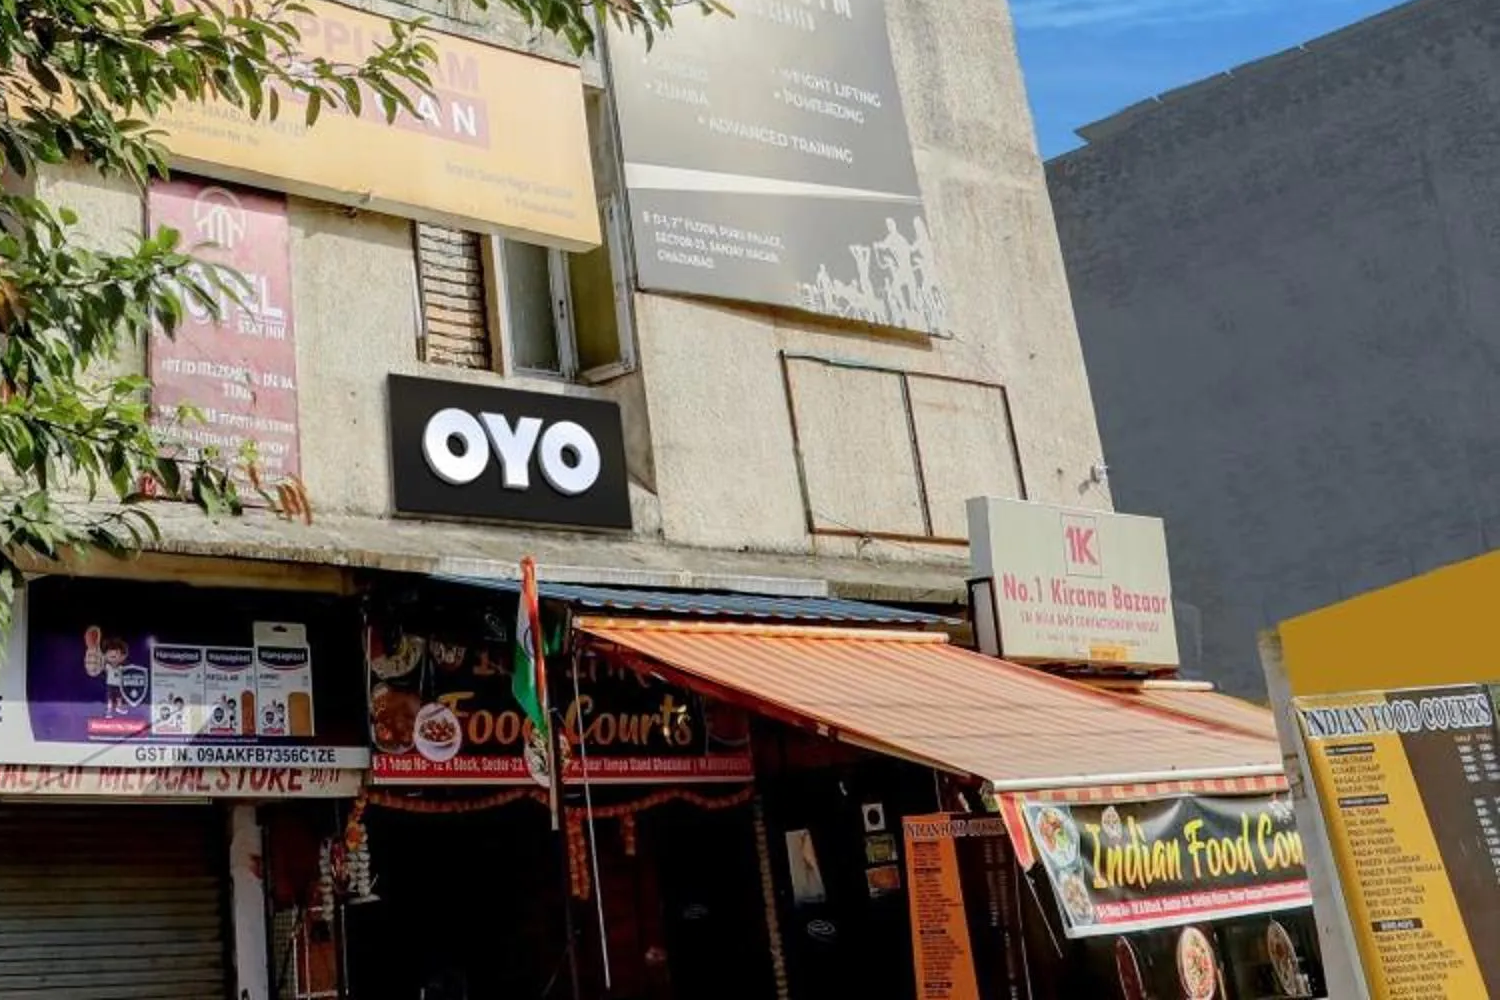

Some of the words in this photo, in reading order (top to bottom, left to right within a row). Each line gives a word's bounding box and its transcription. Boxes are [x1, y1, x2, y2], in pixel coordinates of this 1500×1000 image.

[709, 117, 788, 148] ADVANCED
[791, 135, 853, 164] TRAINING
[422, 408, 600, 495] OYO
[1065, 525, 1099, 565] 1K
[1003, 572, 1043, 603] No.1
[1051, 577, 1107, 609] Kirana
[1111, 583, 1167, 615] Bazaar
[565, 693, 693, 748] Courts
[1371, 701, 1420, 733] FOOD
[1421, 693, 1493, 730] COURTS
[135, 747, 169, 762] GST
[197, 748, 336, 763] 09AAKFB7356C1ZE
[215, 767, 303, 793] STORE
[1084, 816, 1183, 889] Indian
[1183, 811, 1258, 879] Food
